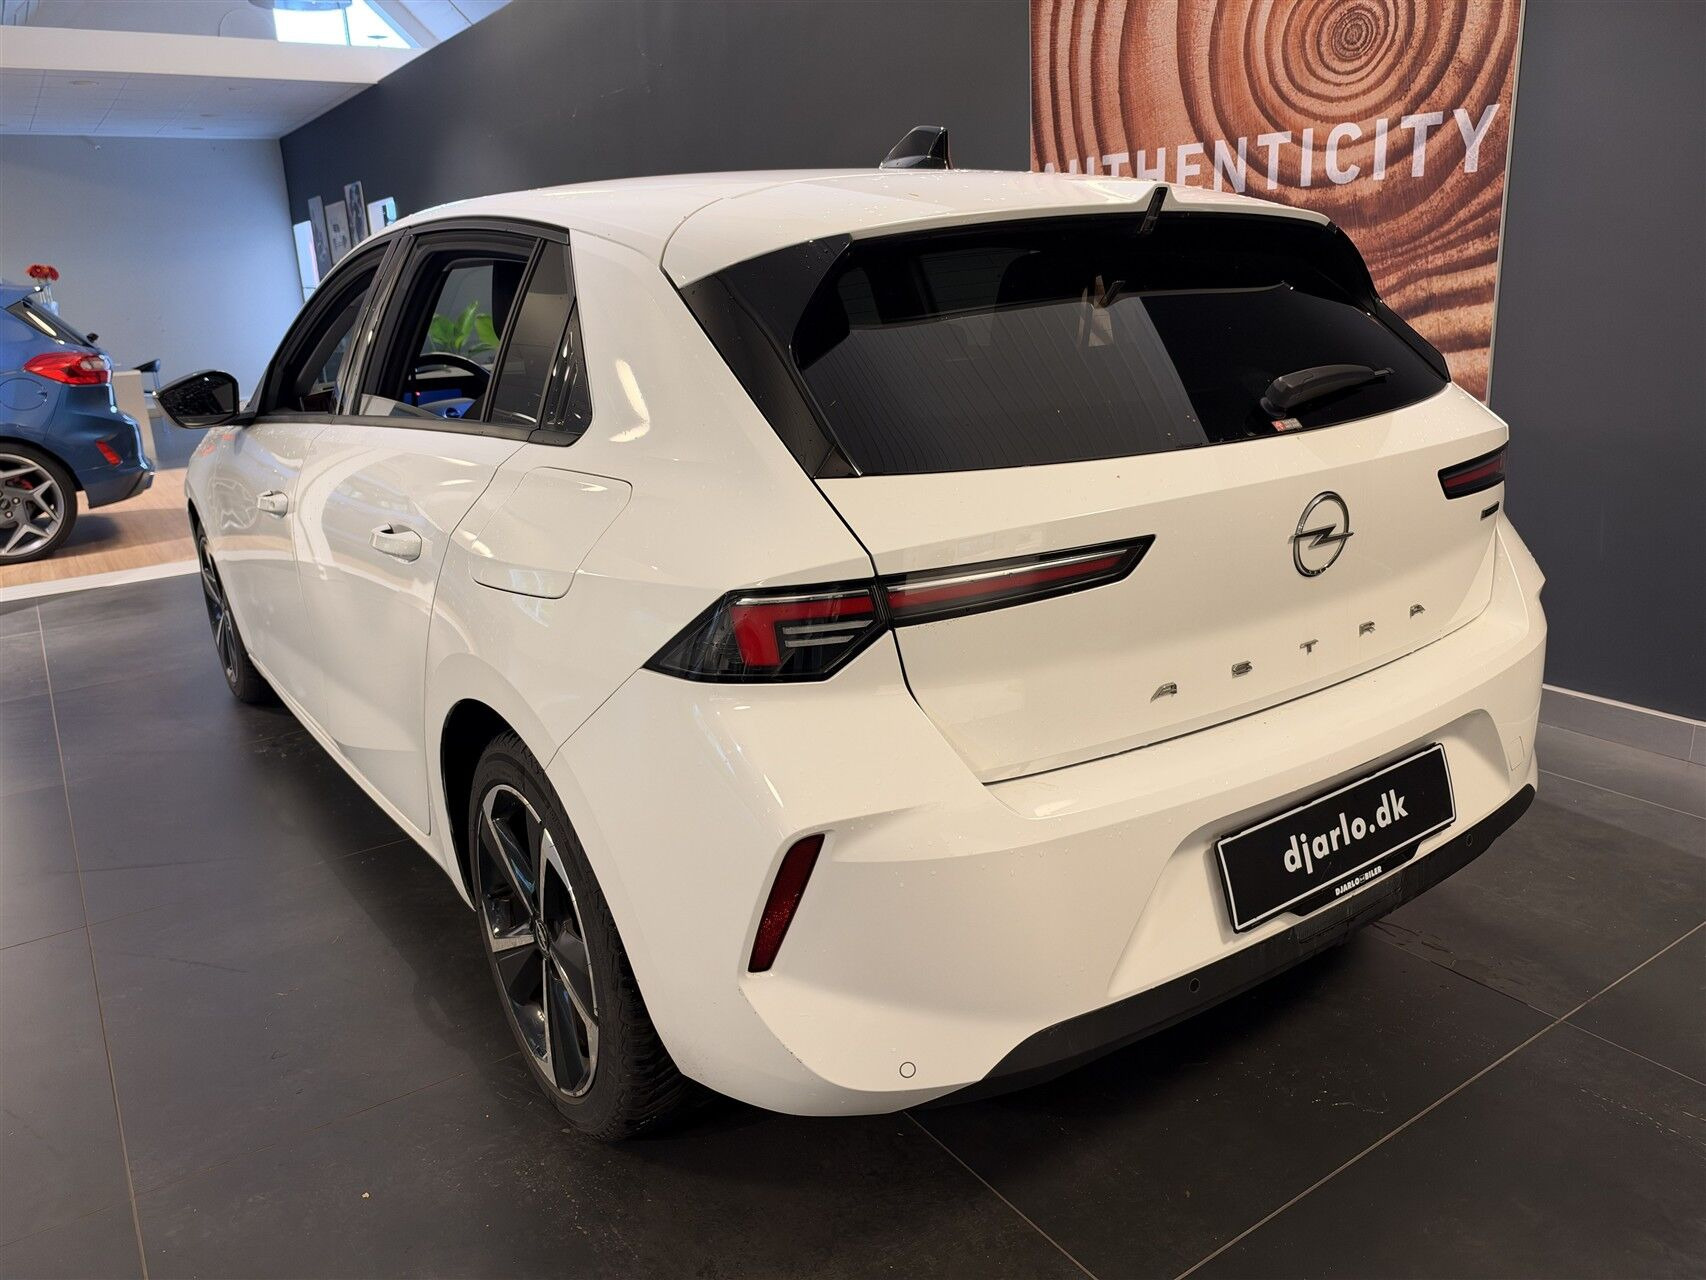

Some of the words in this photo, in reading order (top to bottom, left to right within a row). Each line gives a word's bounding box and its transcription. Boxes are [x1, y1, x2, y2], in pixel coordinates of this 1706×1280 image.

[1149, 603, 1426, 704] ASTRA
[1283, 788, 1409, 875] djarlo.dk
[1334, 877, 1360, 896] DJARLO
[1364, 865, 1383, 881] BILER
